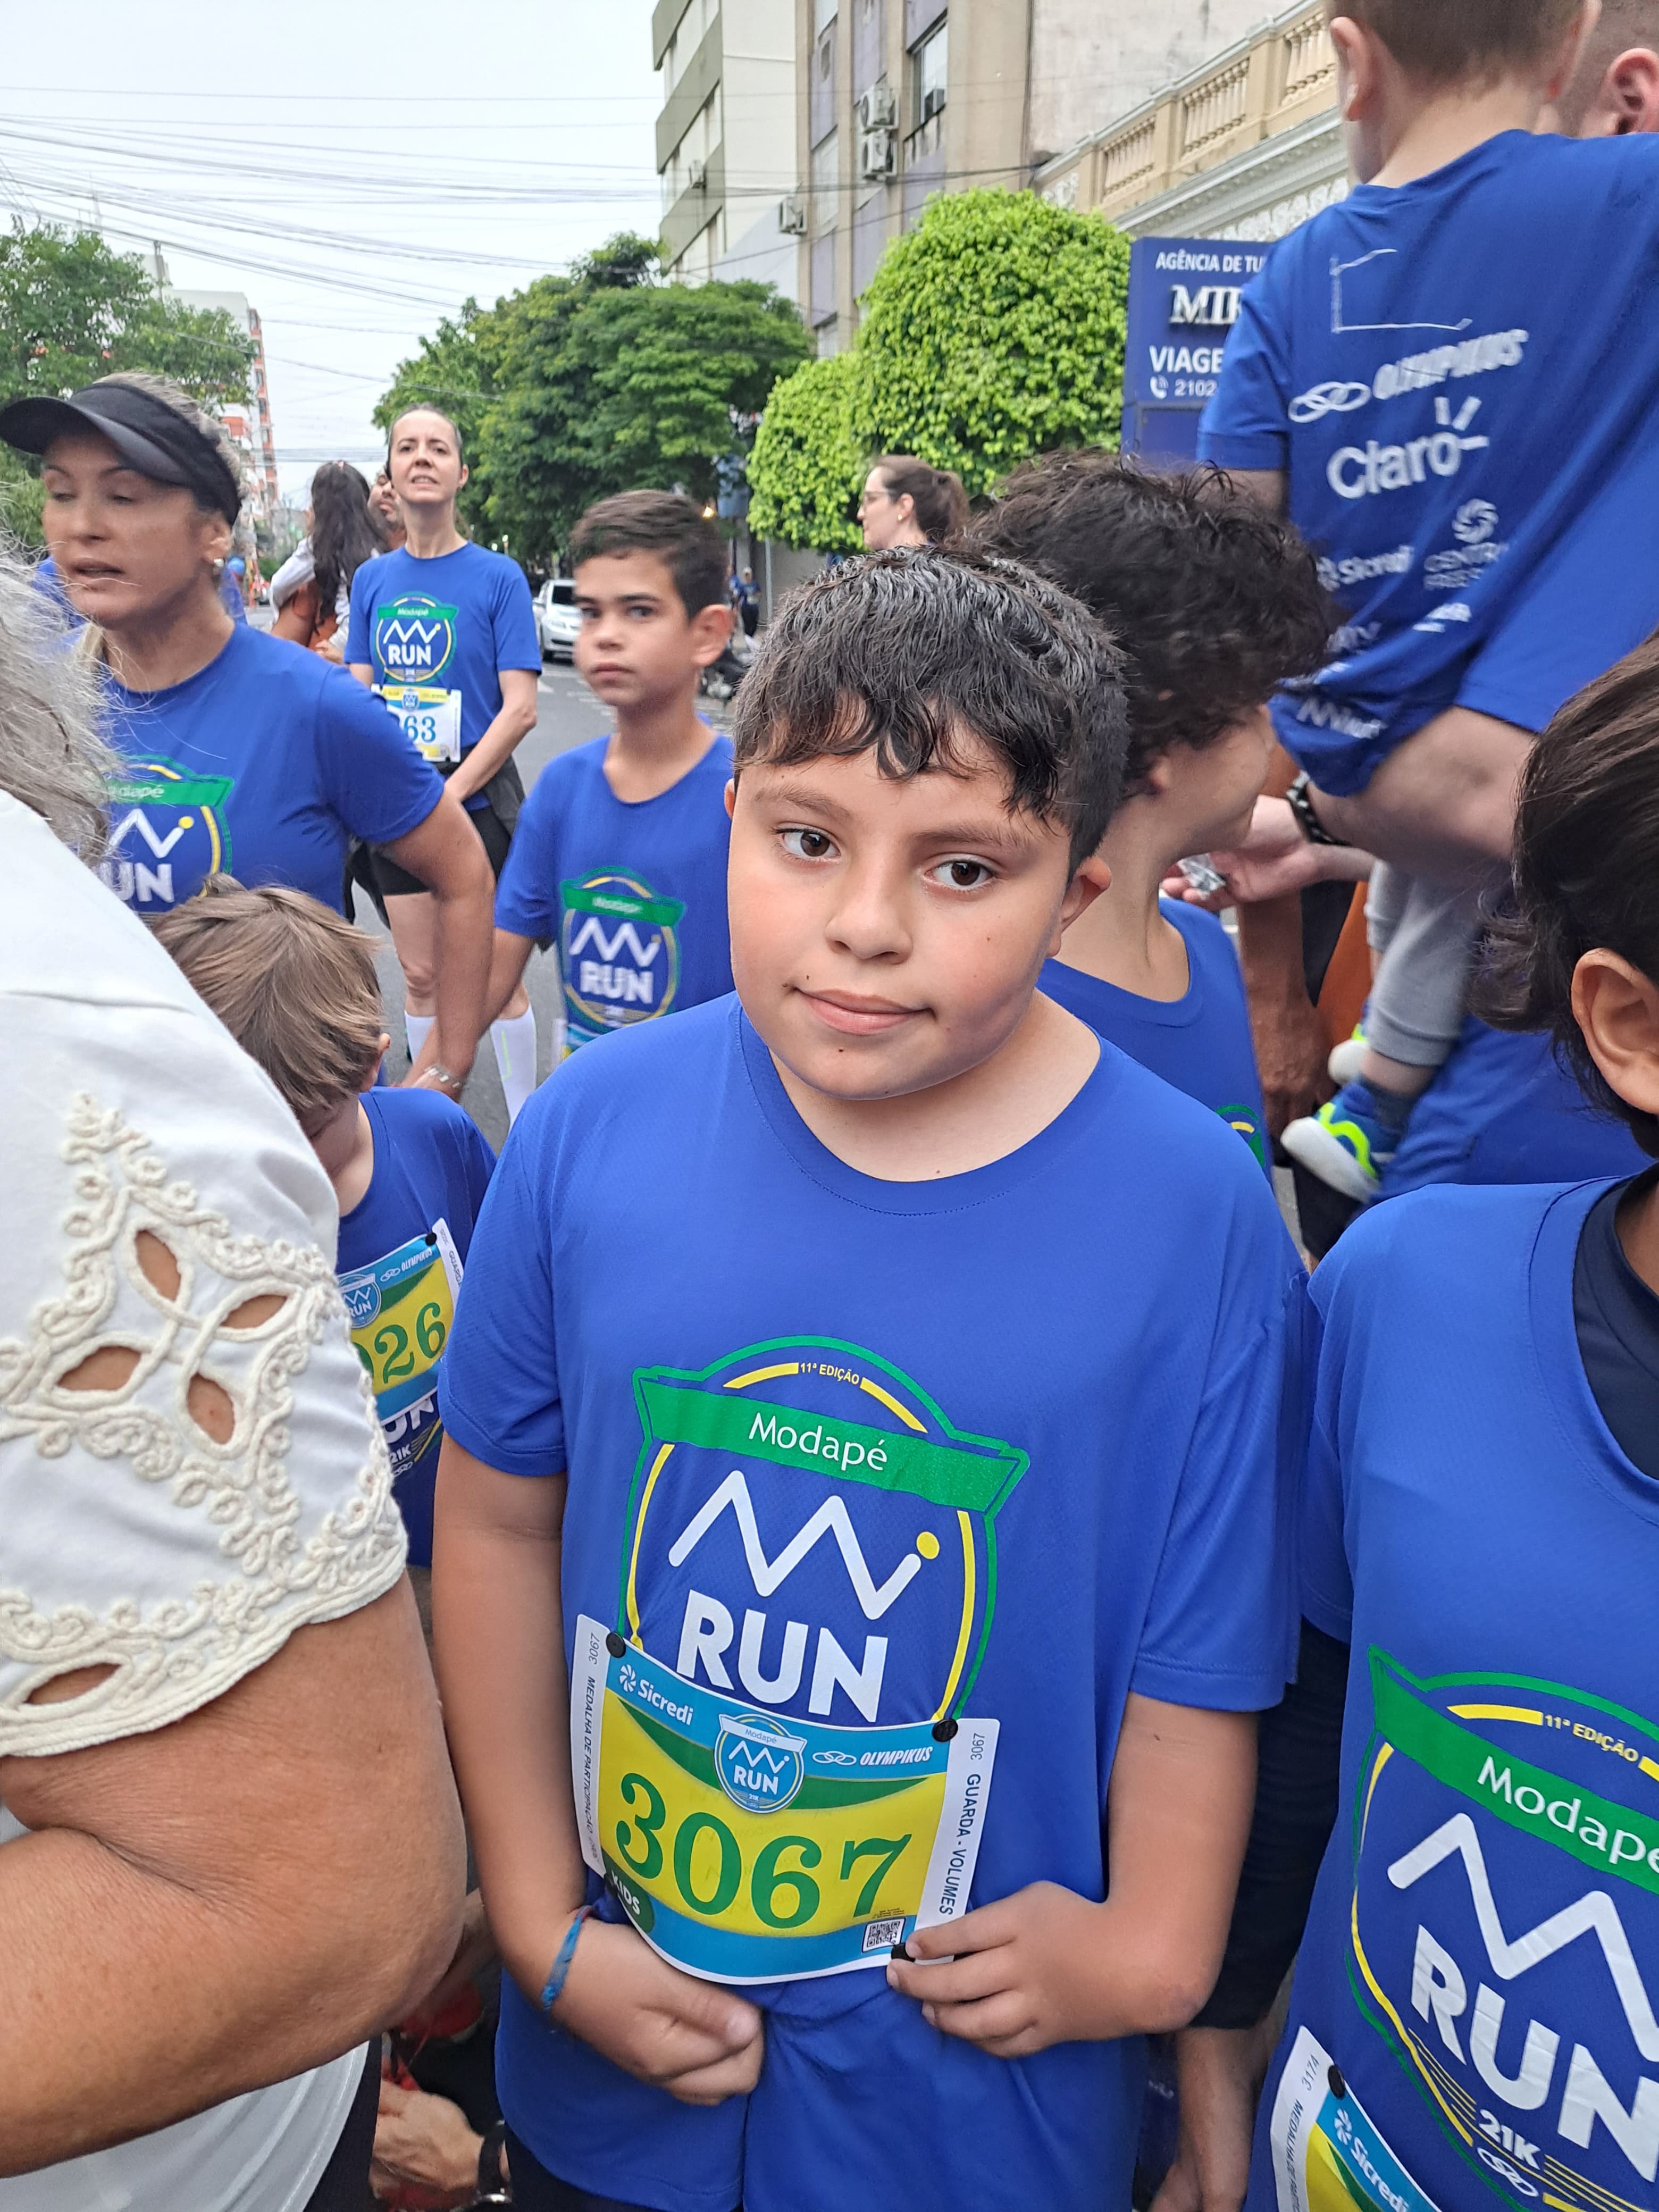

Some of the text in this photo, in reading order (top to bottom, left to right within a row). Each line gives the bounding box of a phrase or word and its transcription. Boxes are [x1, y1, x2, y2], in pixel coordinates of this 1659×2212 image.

[1155, 248, 1220, 272] AGÊNCIA
[1222, 255, 1243, 272] DE
[1174, 379, 1218, 396] 2102
[1327, 432, 1461, 499] Claro
[388, 644, 431, 665] RUN
[404, 715, 436, 743] 63
[99, 861, 175, 903] UN
[580, 960, 653, 1004] RUN
[401, 1247, 433, 1272] OLYMPIKUS
[353, 1302, 446, 1384] 26
[800, 1362, 860, 1385] 11ª EDIÇÃO
[748, 1412, 888, 1472] Modapé
[588, 1632, 601, 1665] 3067
[676, 1589, 889, 1723] RUN
[584, 1675, 596, 1735] MEDALHA
[638, 1679, 693, 1727] Sicredi
[584, 1736, 592, 1756] DE
[745, 1729, 777, 1745] Modapé
[859, 1746, 934, 1766] OLYMPIKUS
[970, 1732, 985, 1761] 3067
[1572, 1722, 1639, 1762] EDIÇÃO
[733, 1764, 779, 1796] RUN
[957, 1773, 982, 1837] GUARDA
[616, 1772, 912, 1930] 3067
[939, 1848, 967, 1916] VOLUMES
[1302, 2054, 1320, 2092] 3174
[1411, 1924, 1659, 2183] RUN
[1286, 2099, 1304, 2162] MEDALHA
[1478, 2108, 1541, 2171] 21K
